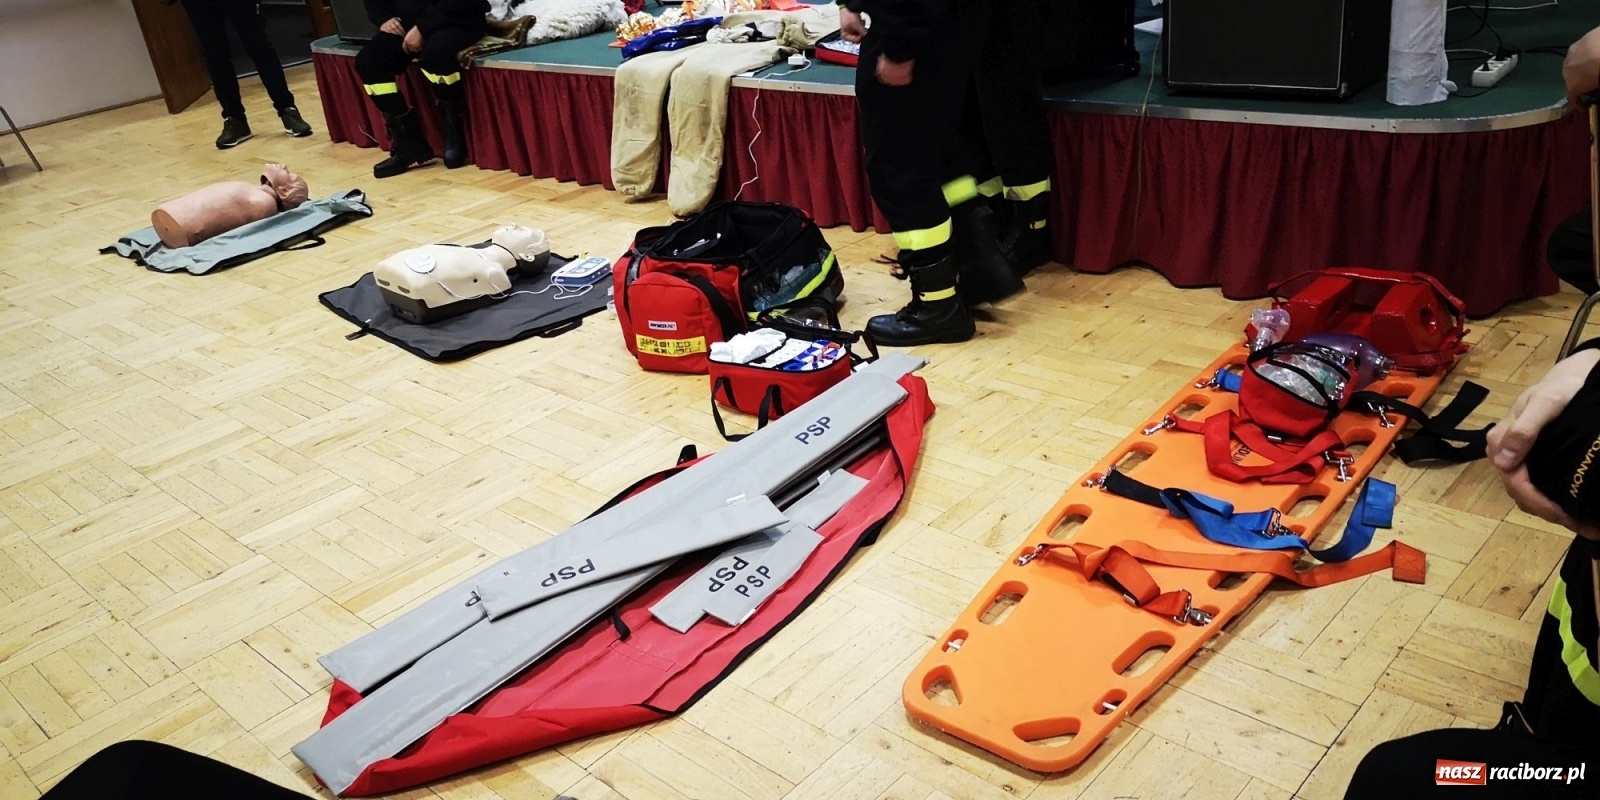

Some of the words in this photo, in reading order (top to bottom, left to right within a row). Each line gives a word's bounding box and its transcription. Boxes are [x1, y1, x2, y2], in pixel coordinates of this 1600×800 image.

[794, 416, 831, 445] PSP
[541, 558, 596, 587] PSP
[708, 556, 750, 592] PSP
[734, 565, 771, 598] PSP
